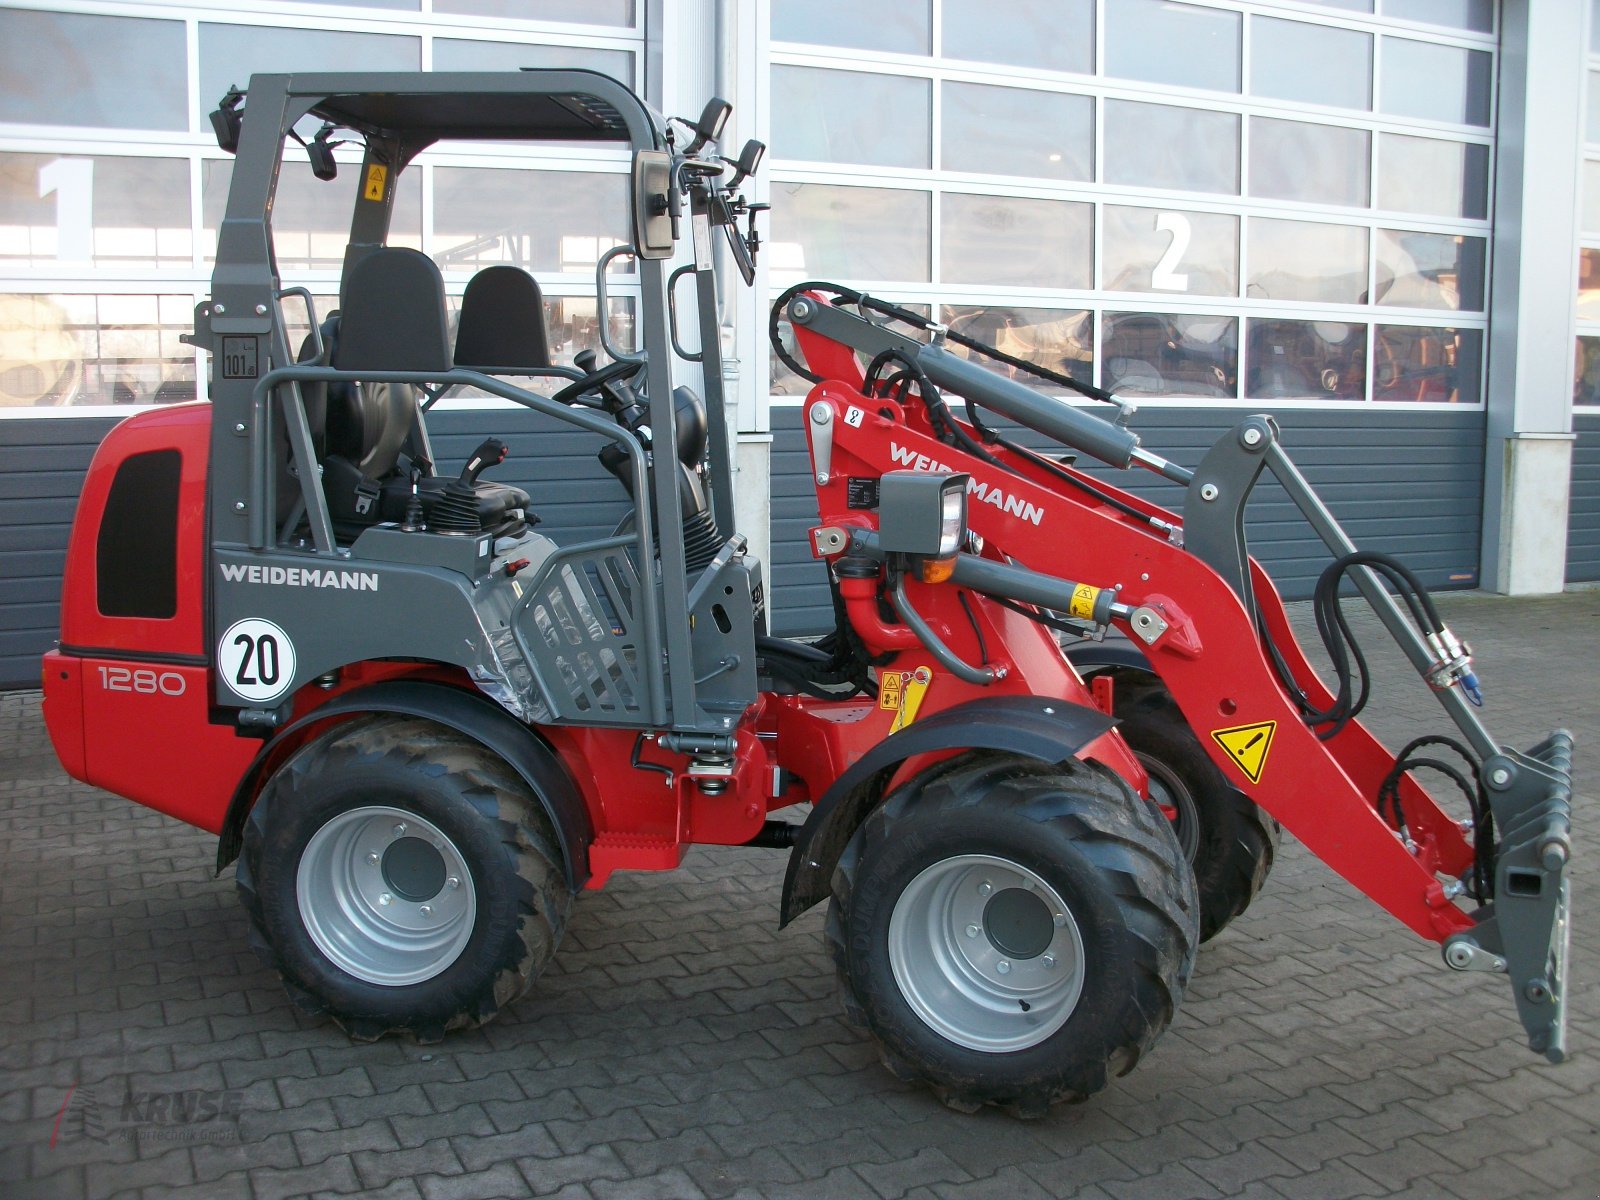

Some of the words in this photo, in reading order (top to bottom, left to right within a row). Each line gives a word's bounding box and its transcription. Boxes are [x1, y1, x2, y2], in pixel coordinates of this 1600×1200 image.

[38, 158, 94, 263] 1
[1151, 212, 1191, 291] 2
[226, 355, 245, 375] 101
[219, 563, 379, 592] WEIDEMANN
[234, 633, 280, 686] 20
[98, 666, 187, 696] 1280
